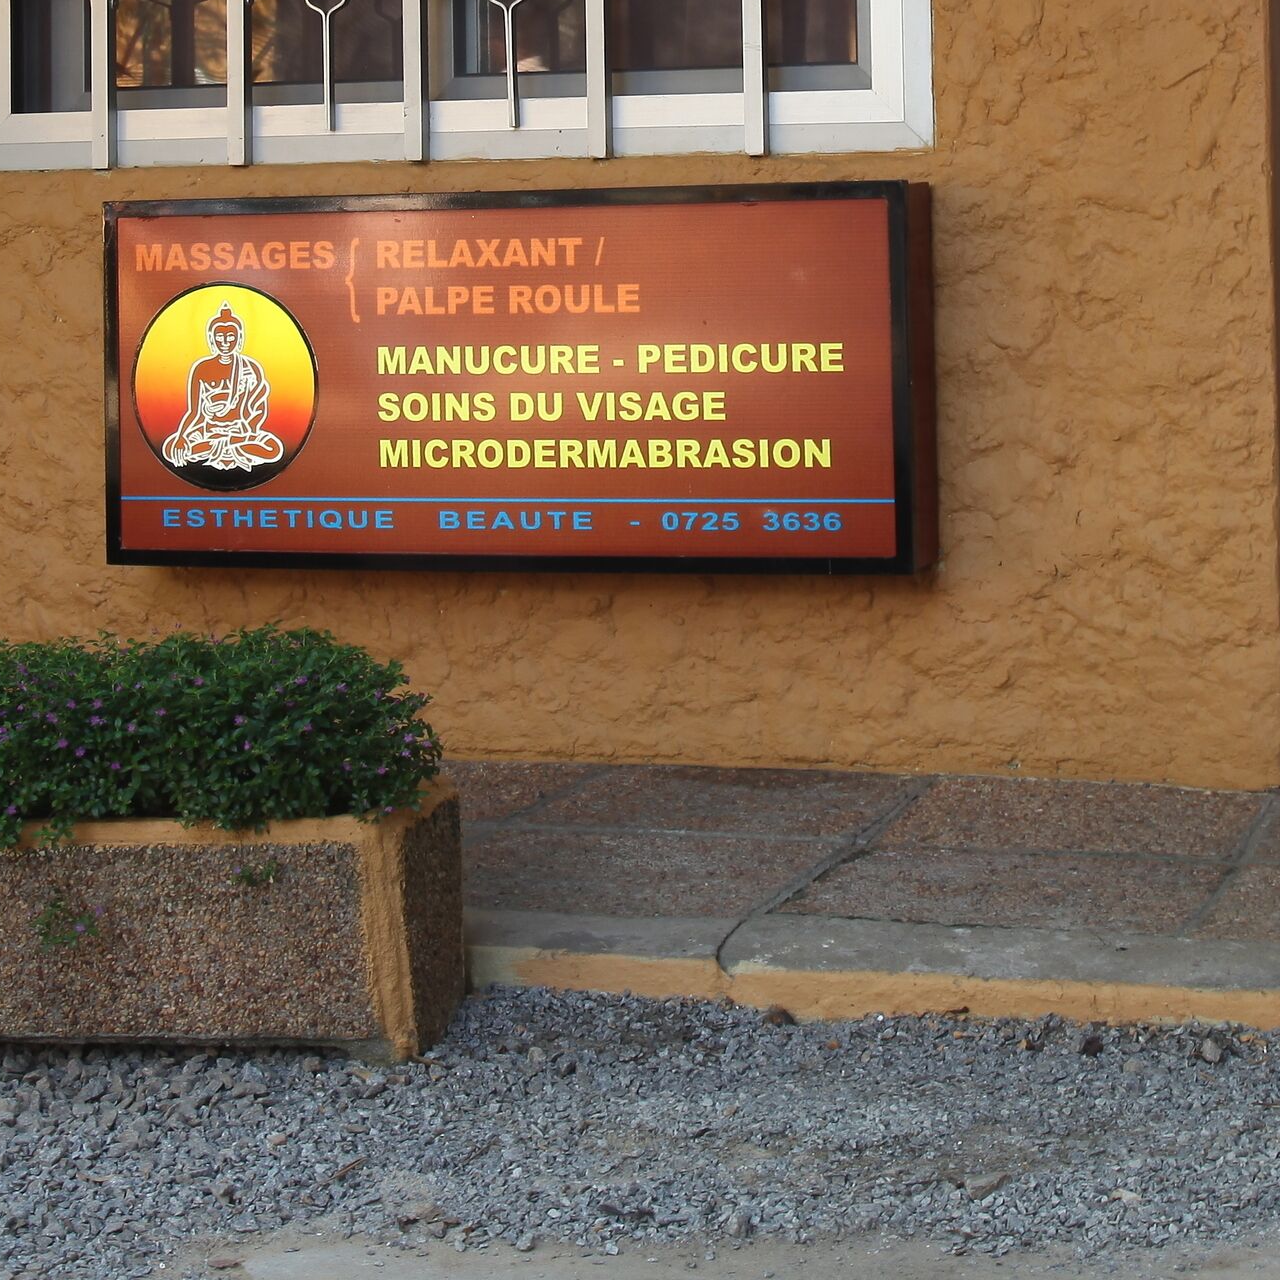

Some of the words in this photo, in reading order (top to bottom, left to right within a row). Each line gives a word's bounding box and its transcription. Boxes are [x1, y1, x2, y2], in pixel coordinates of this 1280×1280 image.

[135, 240, 336, 271] MASSAGES
[376, 237, 583, 269] RELAXANT
[376, 285, 495, 315] PALPE
[508, 283, 641, 314] ROULE
[376, 344, 601, 375] MANUCURE
[637, 342, 845, 373] PEDICURE
[377, 392, 497, 422] SOINS
[510, 392, 564, 422] DU
[576, 391, 727, 421] VISAGE
[378, 438, 832, 469] MICRODERMABRASION
[162, 508, 395, 529] ESTHETIQUE
[438, 510, 593, 530] BEAUTE
[661, 511, 740, 531] 0725
[762, 511, 843, 531] 3636
